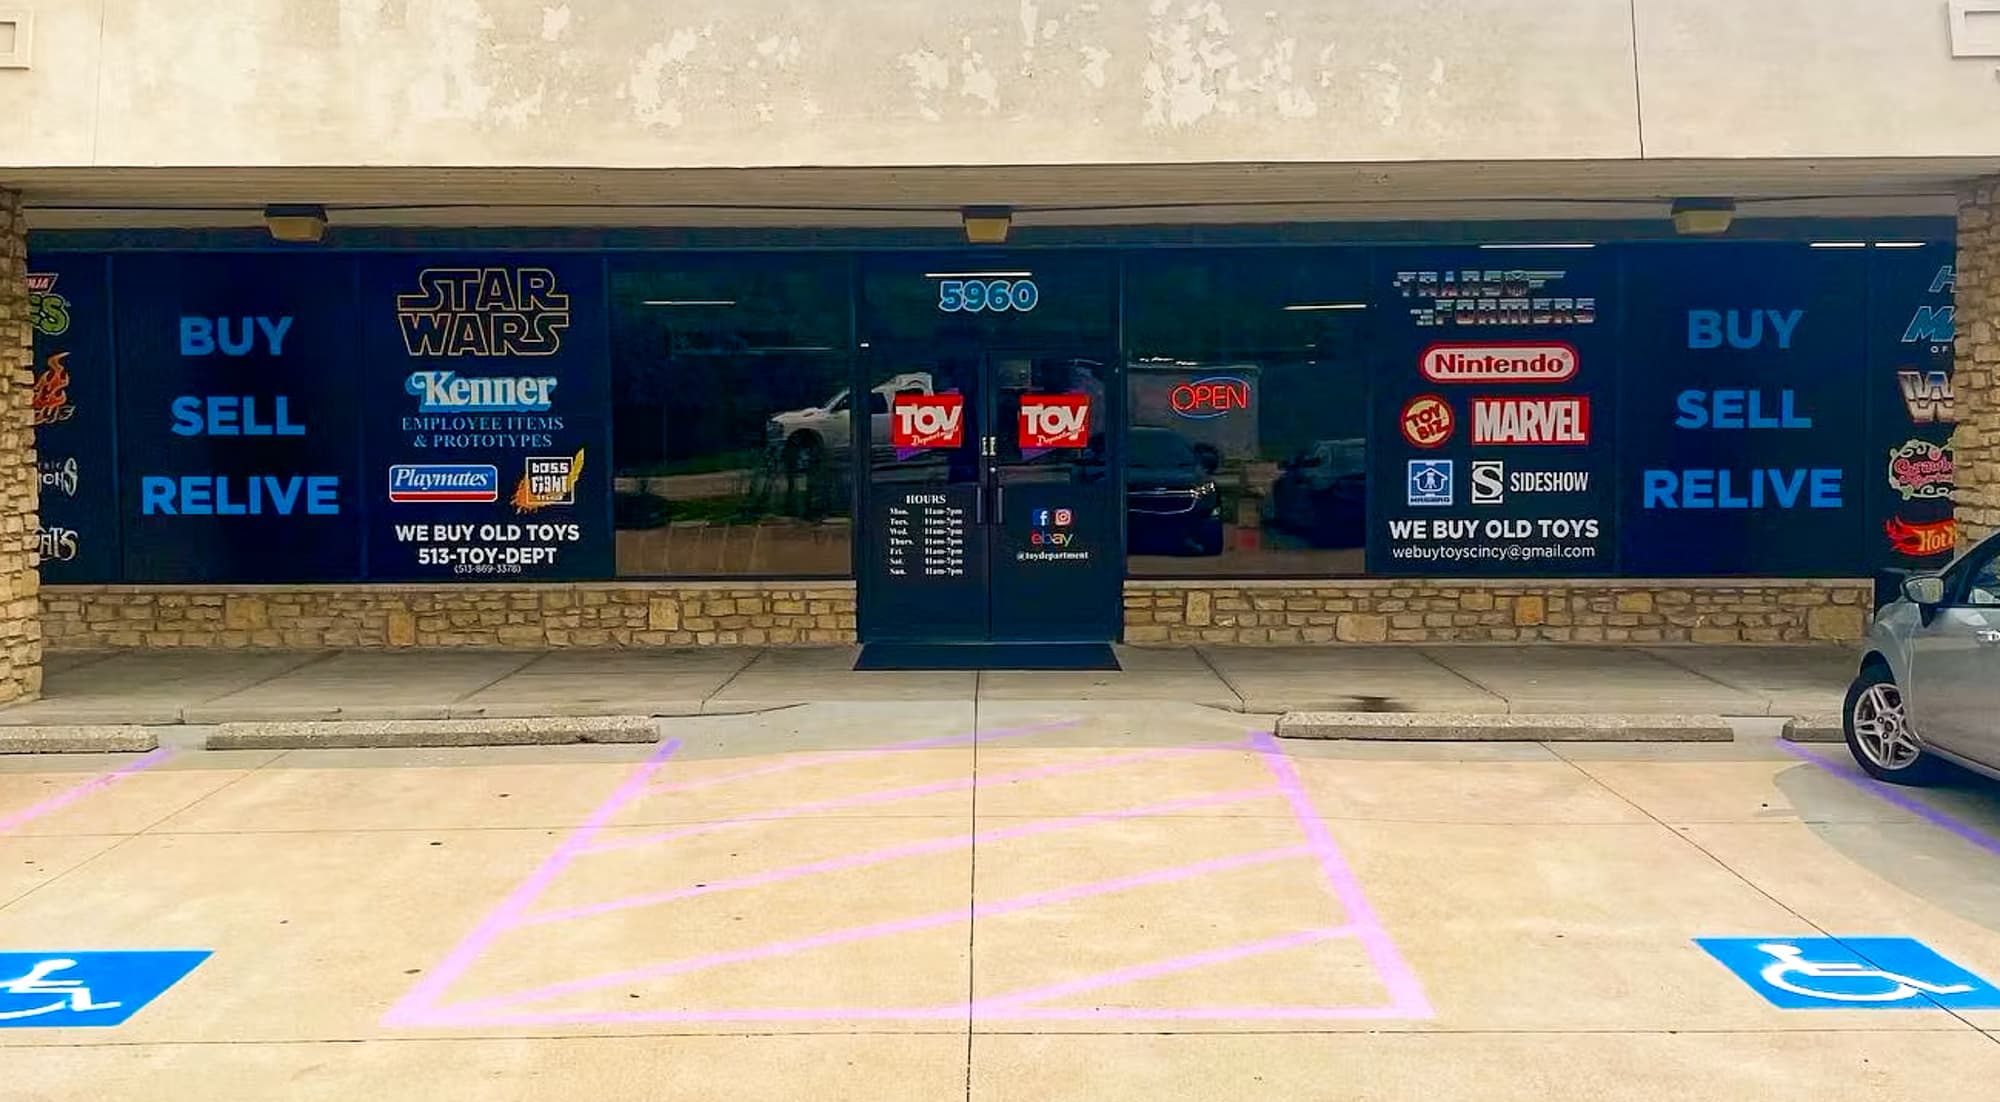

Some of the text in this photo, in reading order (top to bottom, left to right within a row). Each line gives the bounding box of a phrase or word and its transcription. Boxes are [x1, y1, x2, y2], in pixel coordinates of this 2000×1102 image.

[397, 268, 569, 311] STAR
[938, 280, 1039, 311] 5960
[179, 316, 293, 356] BUY
[397, 312, 570, 356] WARS
[1687, 309, 1804, 349] BUY
[1434, 353, 1564, 374] Nintendo
[408, 370, 558, 408] Kenner
[1171, 384, 1247, 411] OPEN
[170, 395, 306, 437] SELL
[895, 403, 962, 440] TOY
[1021, 403, 1088, 440] TOY
[1406, 403, 1442, 428] TOY
[1474, 400, 1586, 443] MARVEL
[1674, 389, 1813, 430] SELL
[402, 416, 565, 431] EMPLOYEE ITEMS
[1415, 419, 1450, 441] BIZ
[413, 433, 553, 448] & PROTOTYPES
[395, 468, 489, 491] Playmates
[1510, 471, 1589, 492] SIDESHOW
[1642, 468, 1843, 509] RELIVE
[142, 475, 340, 515] RELIVE
[906, 494, 947, 504] HOURS
[395, 525, 580, 542] WE BUY OLD TOYS
[1031, 530, 1074, 547] ebay
[1388, 519, 1599, 540] WE BUY OLD TOYS
[418, 548, 557, 565] 513-TOY-DEPT
[1016, 551, 1089, 561] @toydepartment
[1392, 544, 1596, 561] webuytoyscincy@gmail.com
